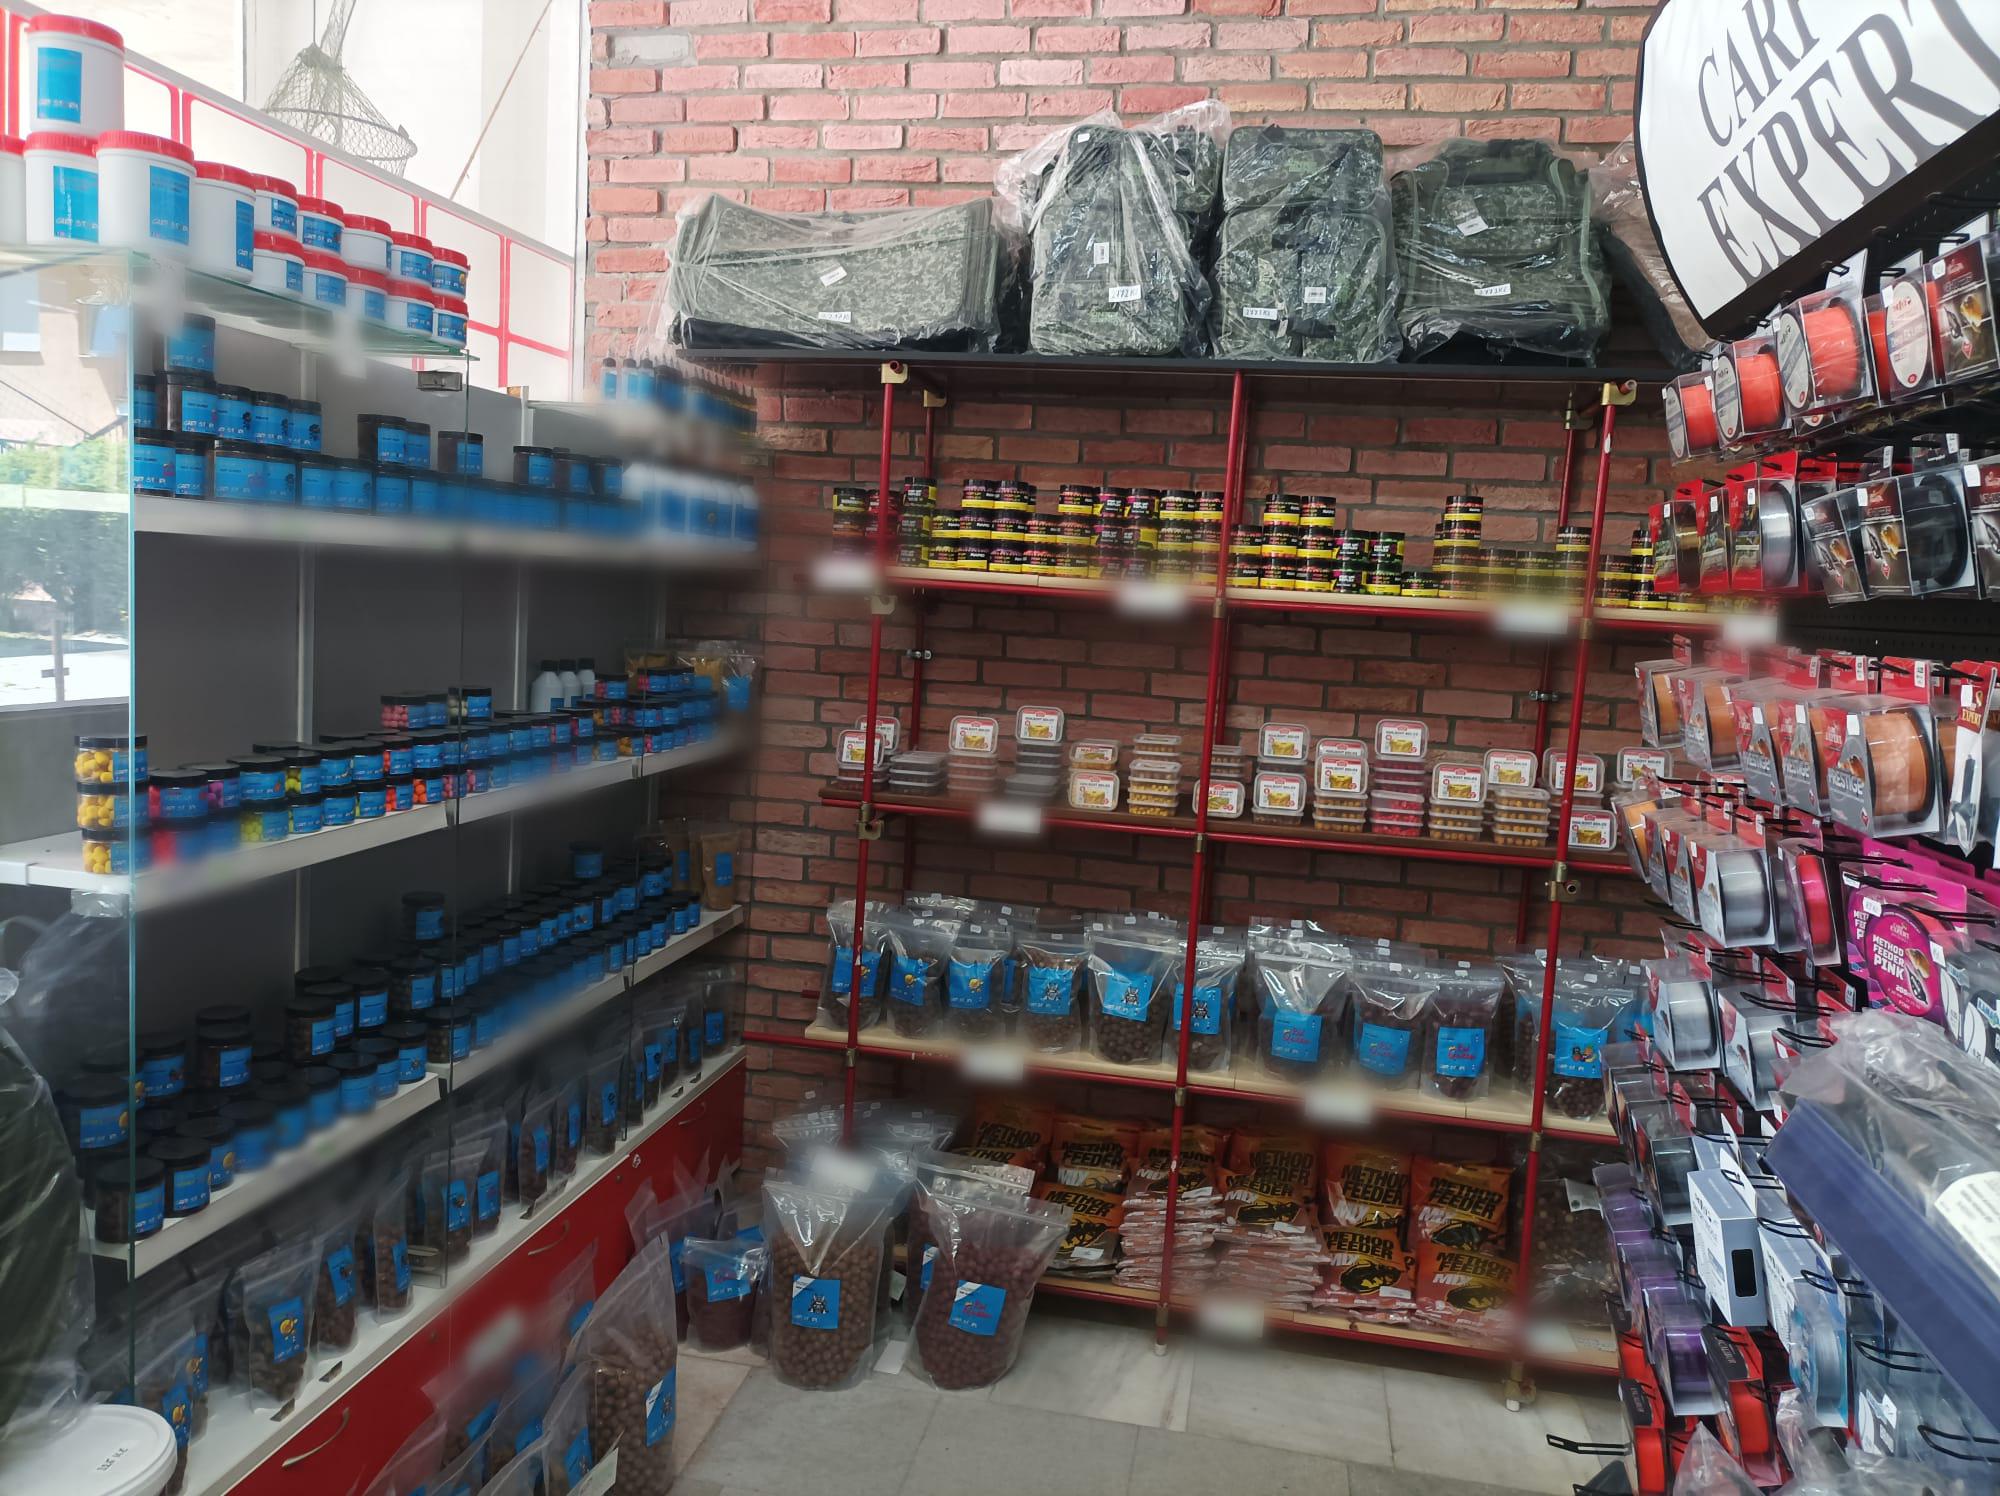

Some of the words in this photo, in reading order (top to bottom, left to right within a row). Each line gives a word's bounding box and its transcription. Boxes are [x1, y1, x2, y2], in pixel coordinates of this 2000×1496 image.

[1872, 934, 1904, 956] METHOD
[1873, 944, 1905, 967] FEEDER
[1873, 954, 1905, 980] PINK
[1430, 1176, 1504, 1203] METHOD
[1428, 1188, 1498, 1219] FEEDER
[1324, 1231, 1394, 1249] METHOD
[1326, 1239, 1394, 1261] FEEDER
[1436, 1251, 1513, 1275] METHOD
[1437, 1257, 1511, 1283] FEEDER
[1432, 1273, 1473, 1286] MIX
